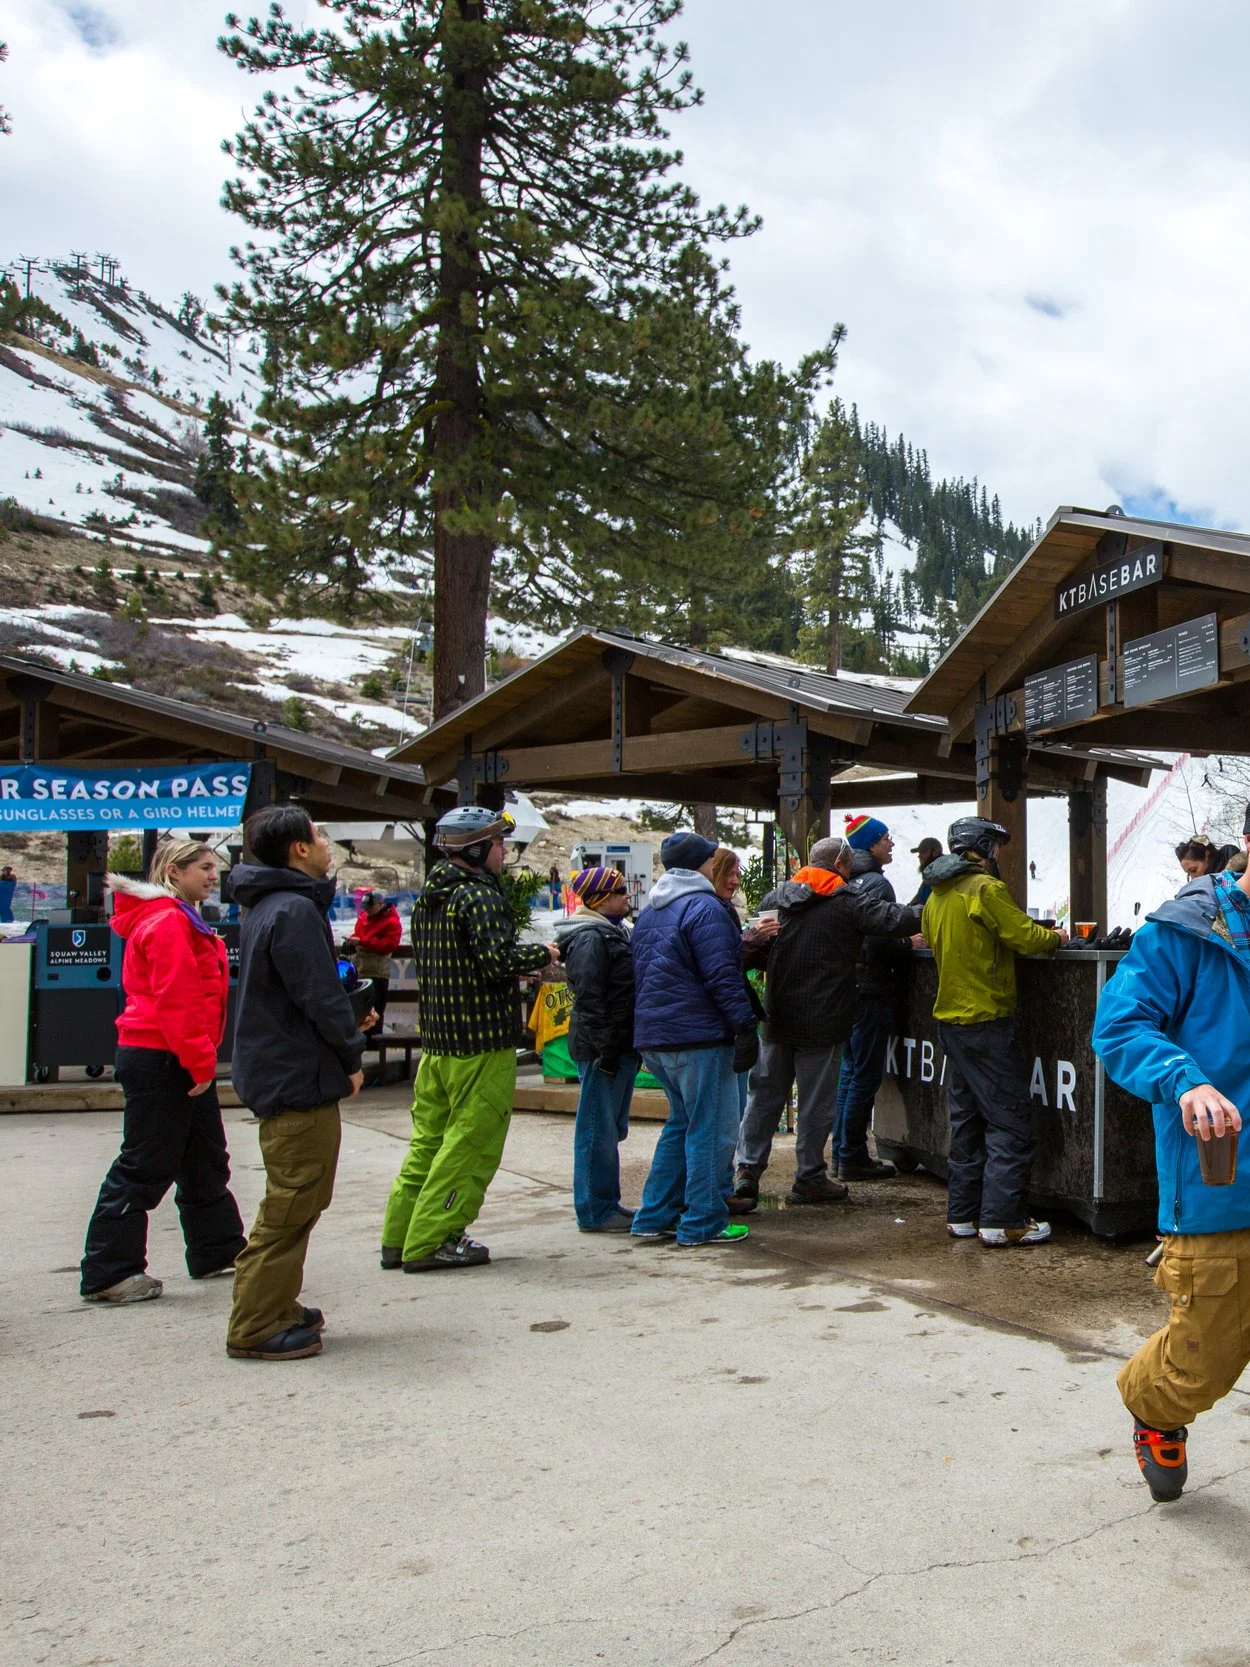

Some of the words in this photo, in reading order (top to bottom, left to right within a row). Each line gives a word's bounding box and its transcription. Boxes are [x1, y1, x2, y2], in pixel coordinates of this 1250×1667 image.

[33, 779, 160, 800] SEASON
[171, 775, 248, 799] PASS
[100, 808, 124, 820] OR
[128, 808, 140, 819] A
[143, 807, 182, 819] GIRO
[187, 805, 242, 818] HELMET
